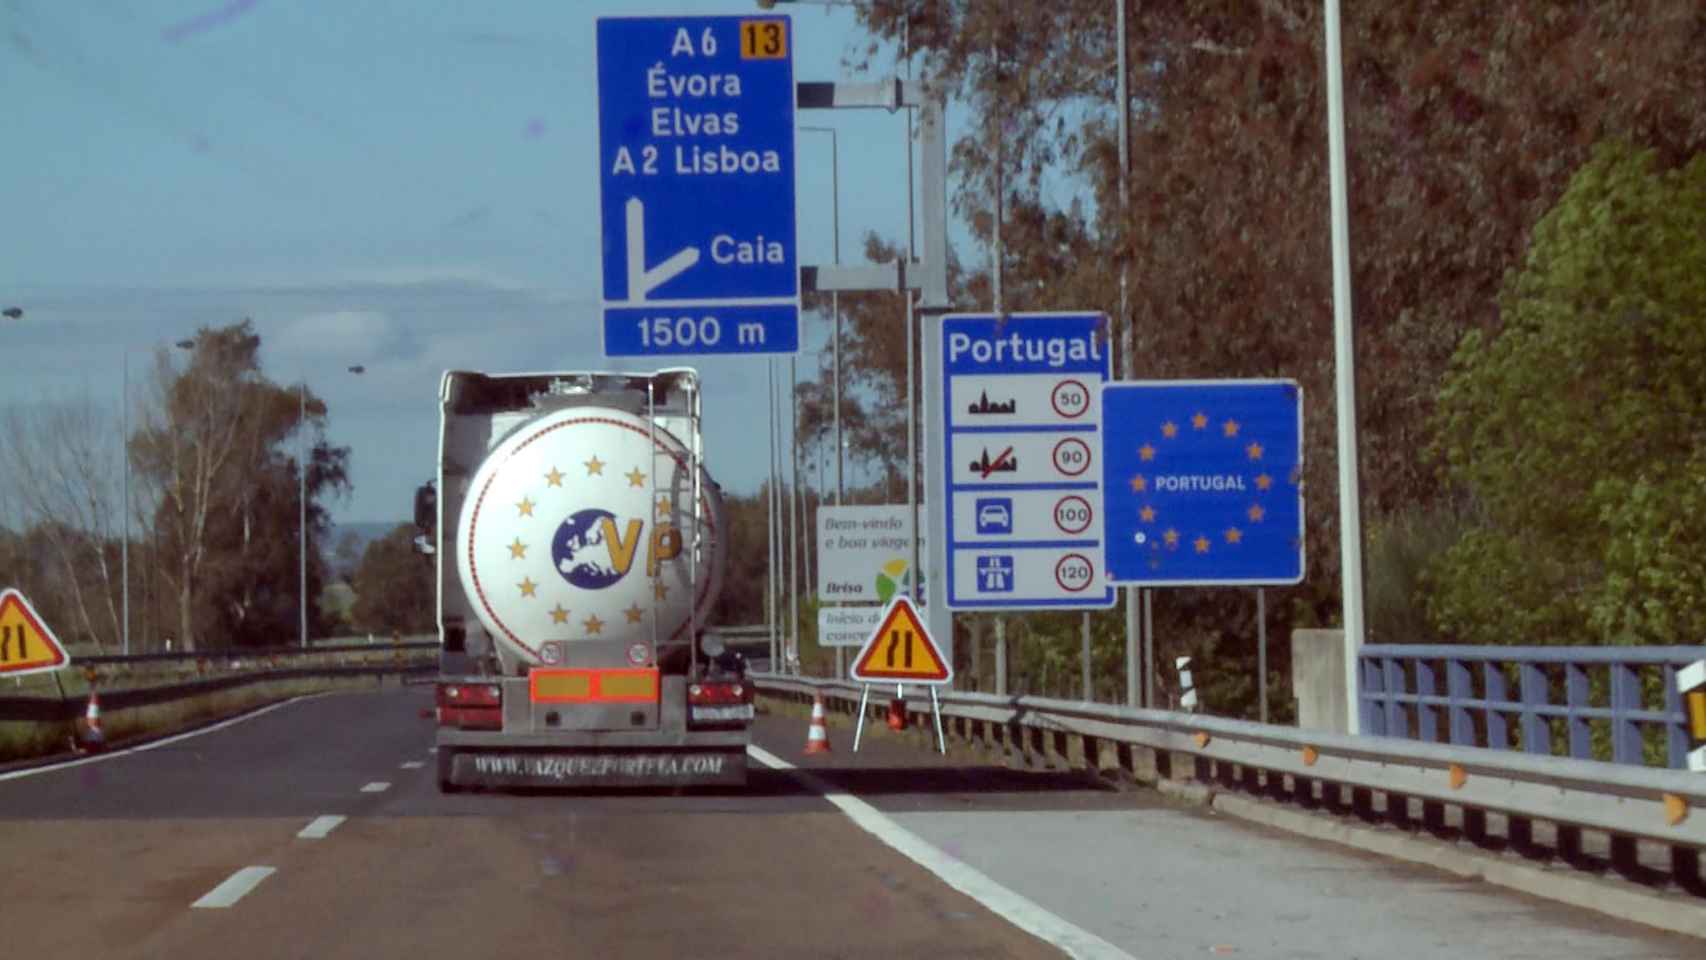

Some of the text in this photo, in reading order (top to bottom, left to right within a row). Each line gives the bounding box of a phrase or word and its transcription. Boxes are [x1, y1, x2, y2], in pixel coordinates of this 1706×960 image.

[671, 27, 717, 56] A 6
[745, 24, 781, 54] 13
[647, 61, 741, 97] Évora
[652, 107, 739, 136] Elvas
[612, 145, 780, 175] A 2 Lisboa
[711, 235, 785, 264] Caia
[638, 318, 765, 348] 1500 m
[950, 331, 1101, 367] Portugal
[1061, 393, 1082, 406] 50
[1062, 451, 1083, 464] 90
[1156, 475, 1246, 491] PORTUGAL
[1059, 508, 1087, 521] 100
[1061, 566, 1088, 579] 120
